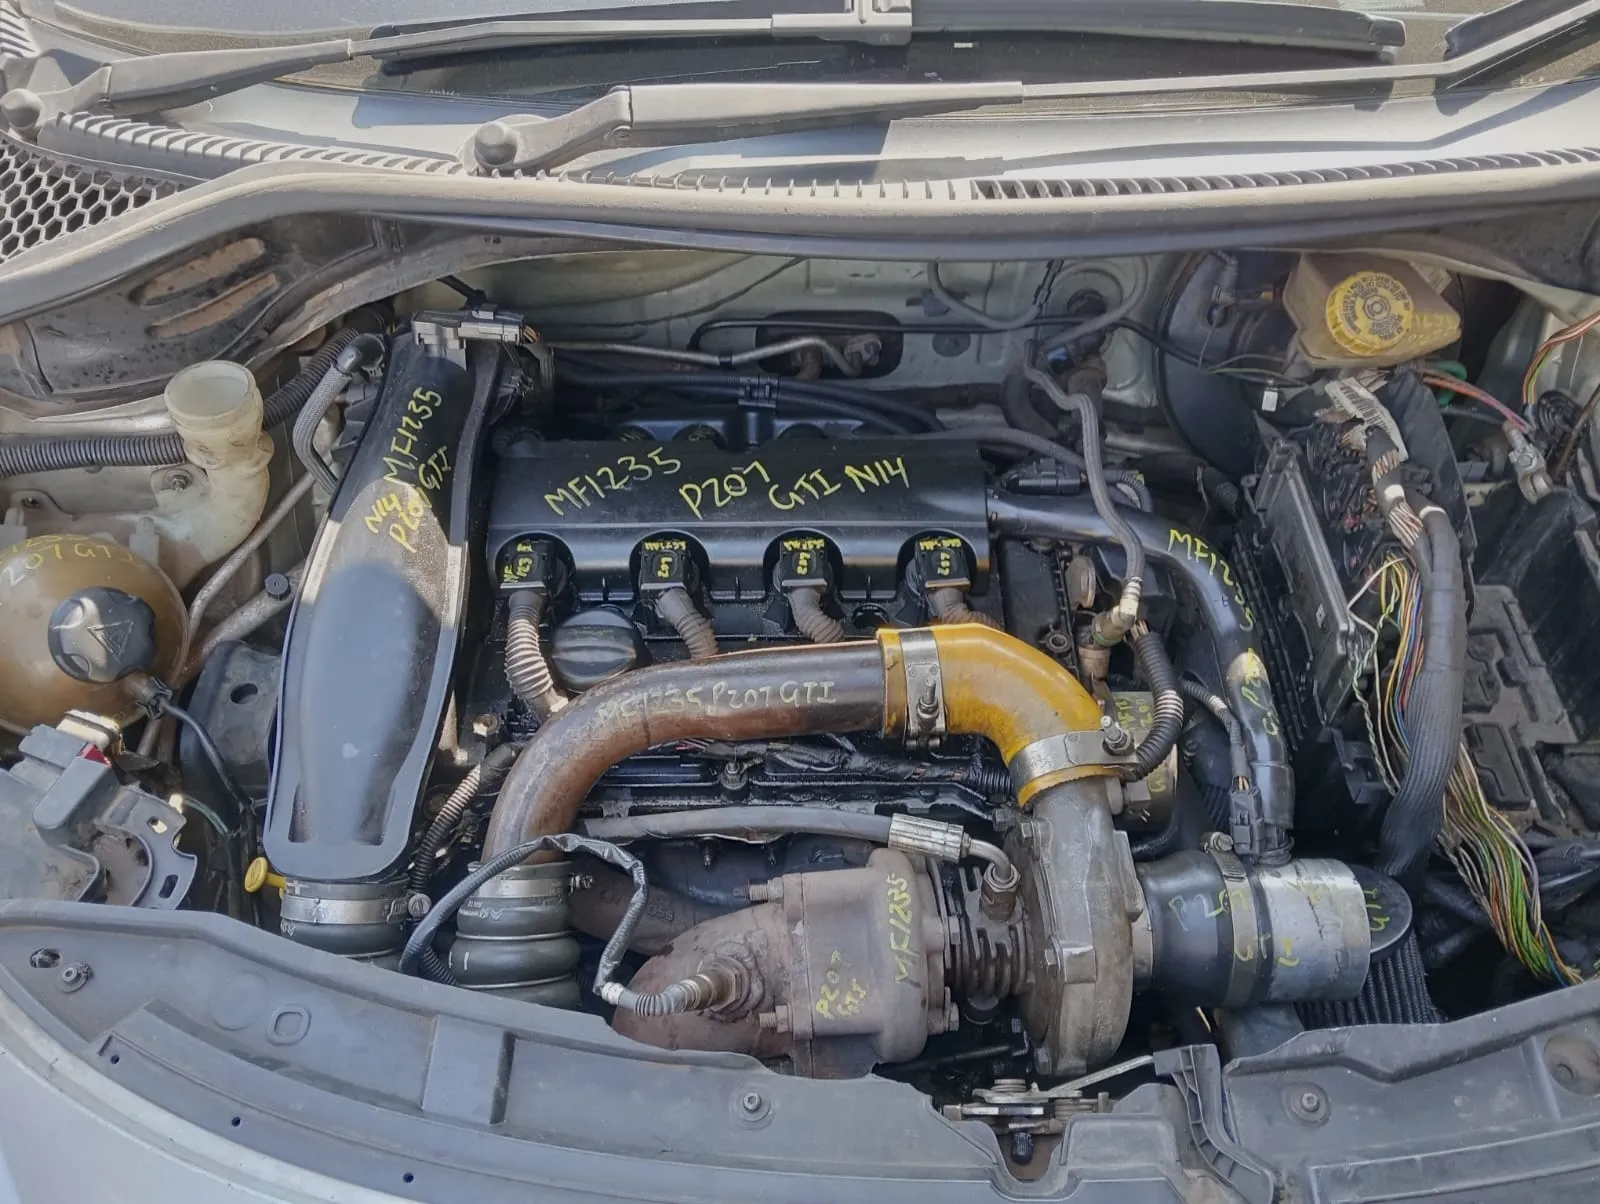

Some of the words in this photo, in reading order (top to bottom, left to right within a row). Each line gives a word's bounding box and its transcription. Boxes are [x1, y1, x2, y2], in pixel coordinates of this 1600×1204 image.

[418, 445, 452, 491] GTI
[543, 446, 682, 516] MF1235
[678, 460, 770, 520] P207
[768, 467, 841, 511] GTI
[843, 455, 910, 493] N14
[779, 679, 837, 709] GTI
